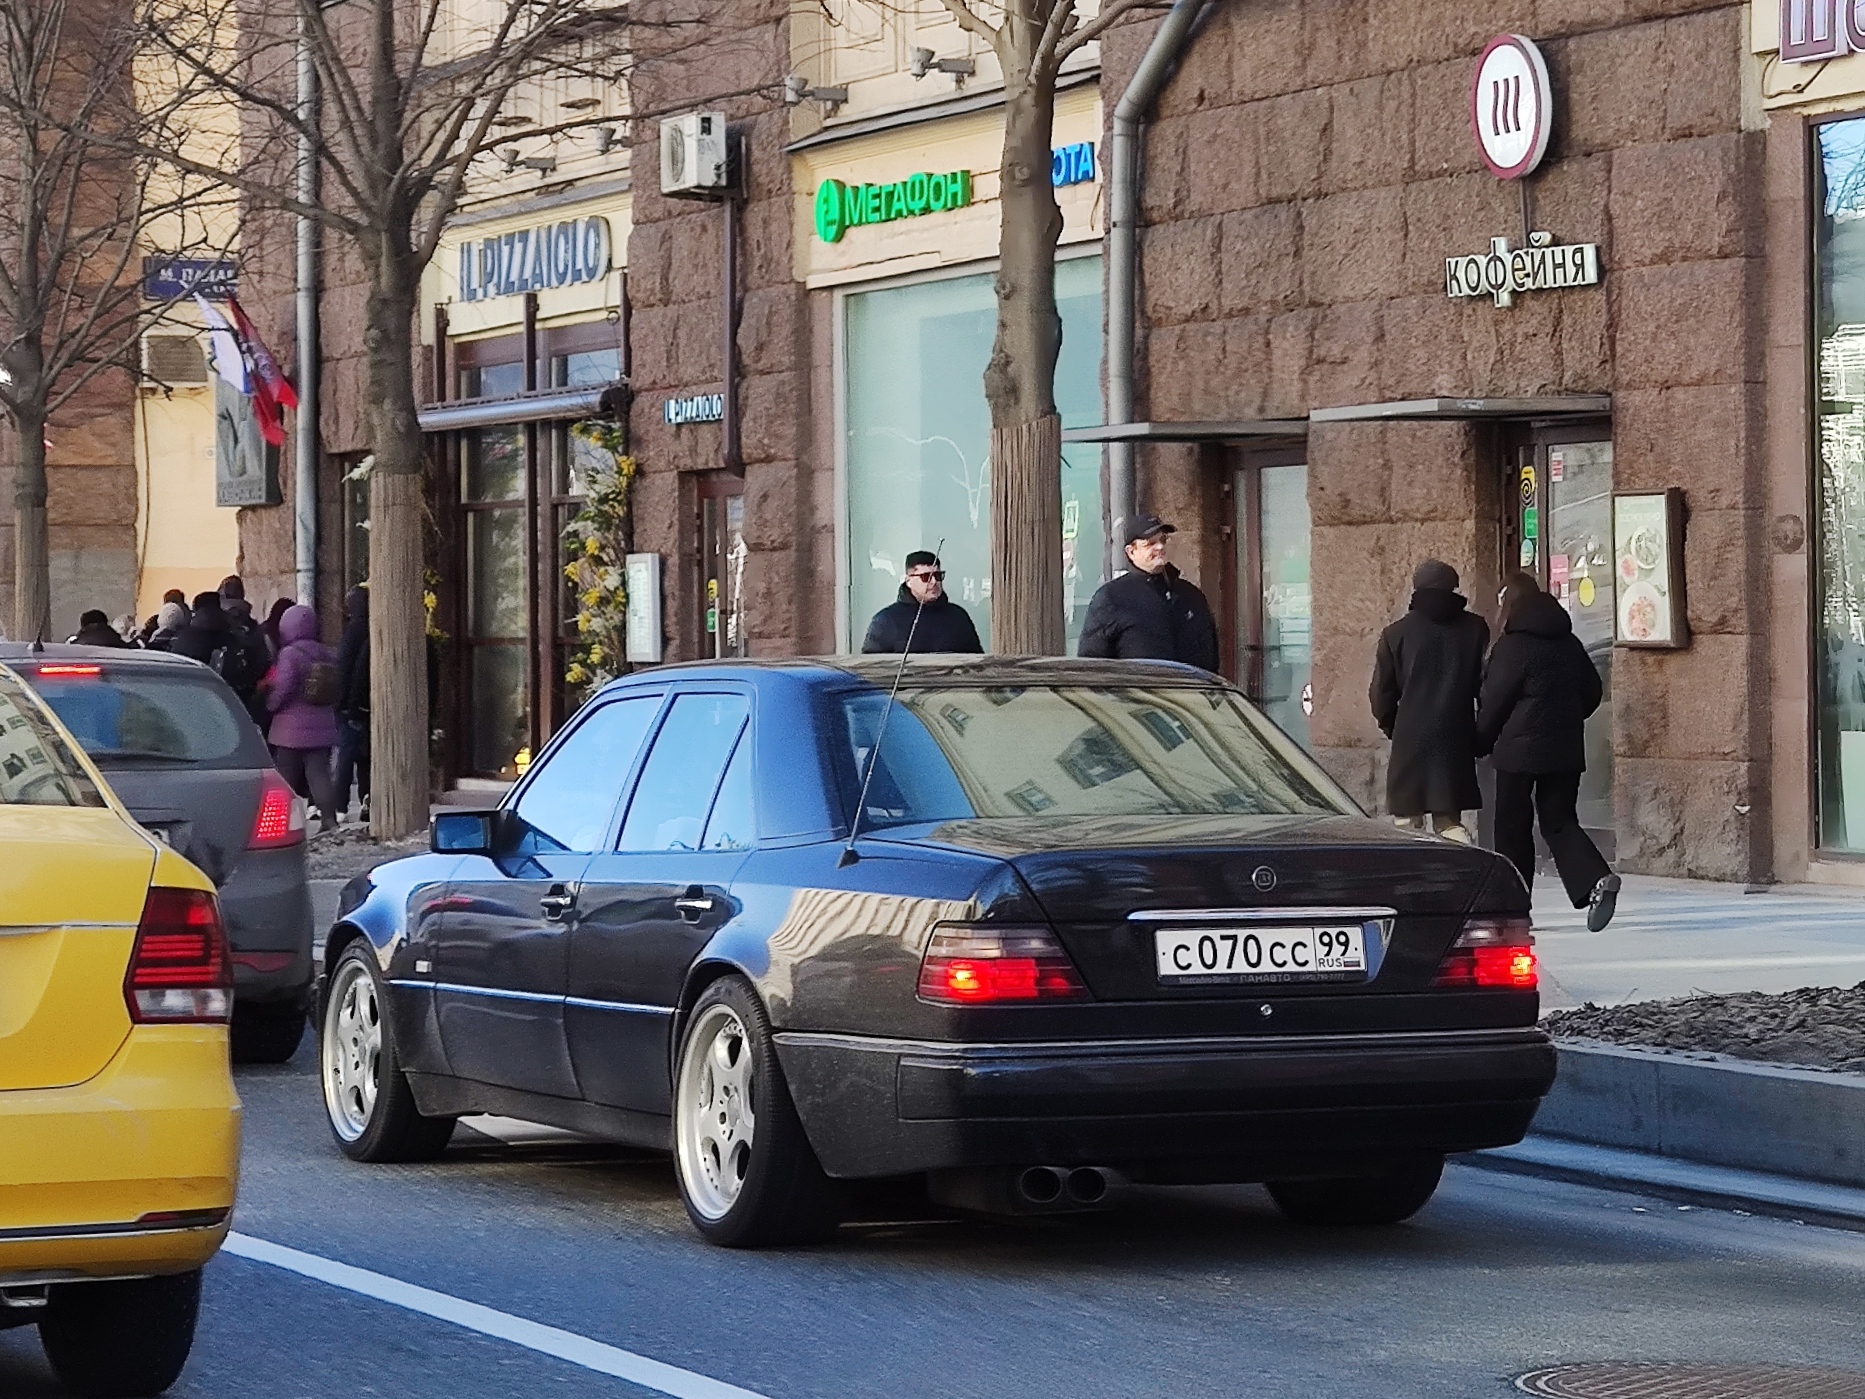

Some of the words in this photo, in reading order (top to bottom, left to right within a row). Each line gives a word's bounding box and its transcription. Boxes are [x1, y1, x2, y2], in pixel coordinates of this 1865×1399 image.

[1052, 142, 1094, 187] OTA
[845, 171, 966, 226] МЕГАФОН
[460, 241, 478, 301] IL
[483, 215, 605, 298] PIZZAIOLO
[674, 394, 723, 422] PIZZAIOLO
[1173, 933, 1310, 971] С070СС
[1318, 930, 1350, 957] 99
[1318, 957, 1343, 968] RUS
